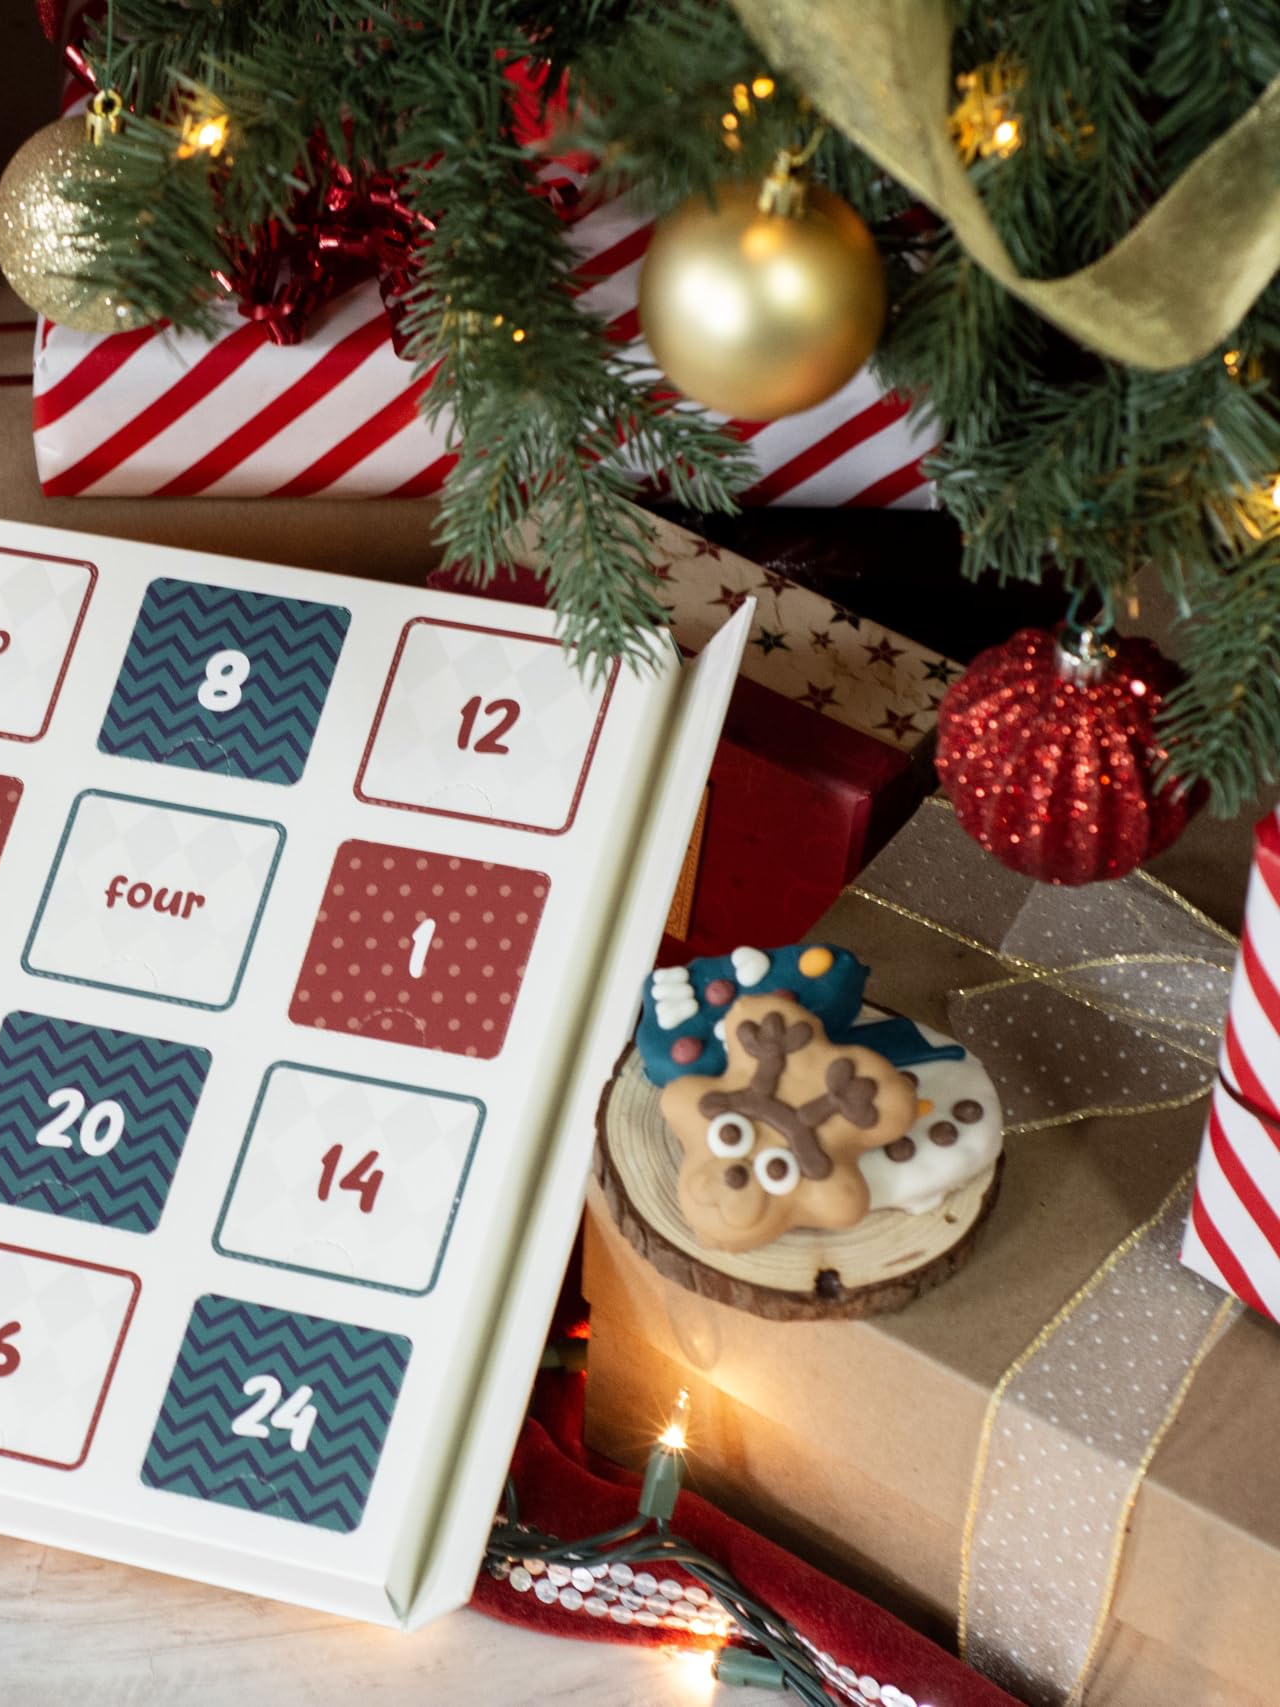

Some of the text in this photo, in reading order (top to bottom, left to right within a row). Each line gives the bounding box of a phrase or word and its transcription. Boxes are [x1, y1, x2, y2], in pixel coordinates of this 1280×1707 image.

[197, 649, 251, 712] 8
[456, 694, 521, 755] 12
[105, 874, 206, 920] four
[409, 918, 436, 979] 1
[36, 1088, 125, 1157] 20
[316, 1142, 386, 1214] 14
[231, 1375, 318, 1452] 24
